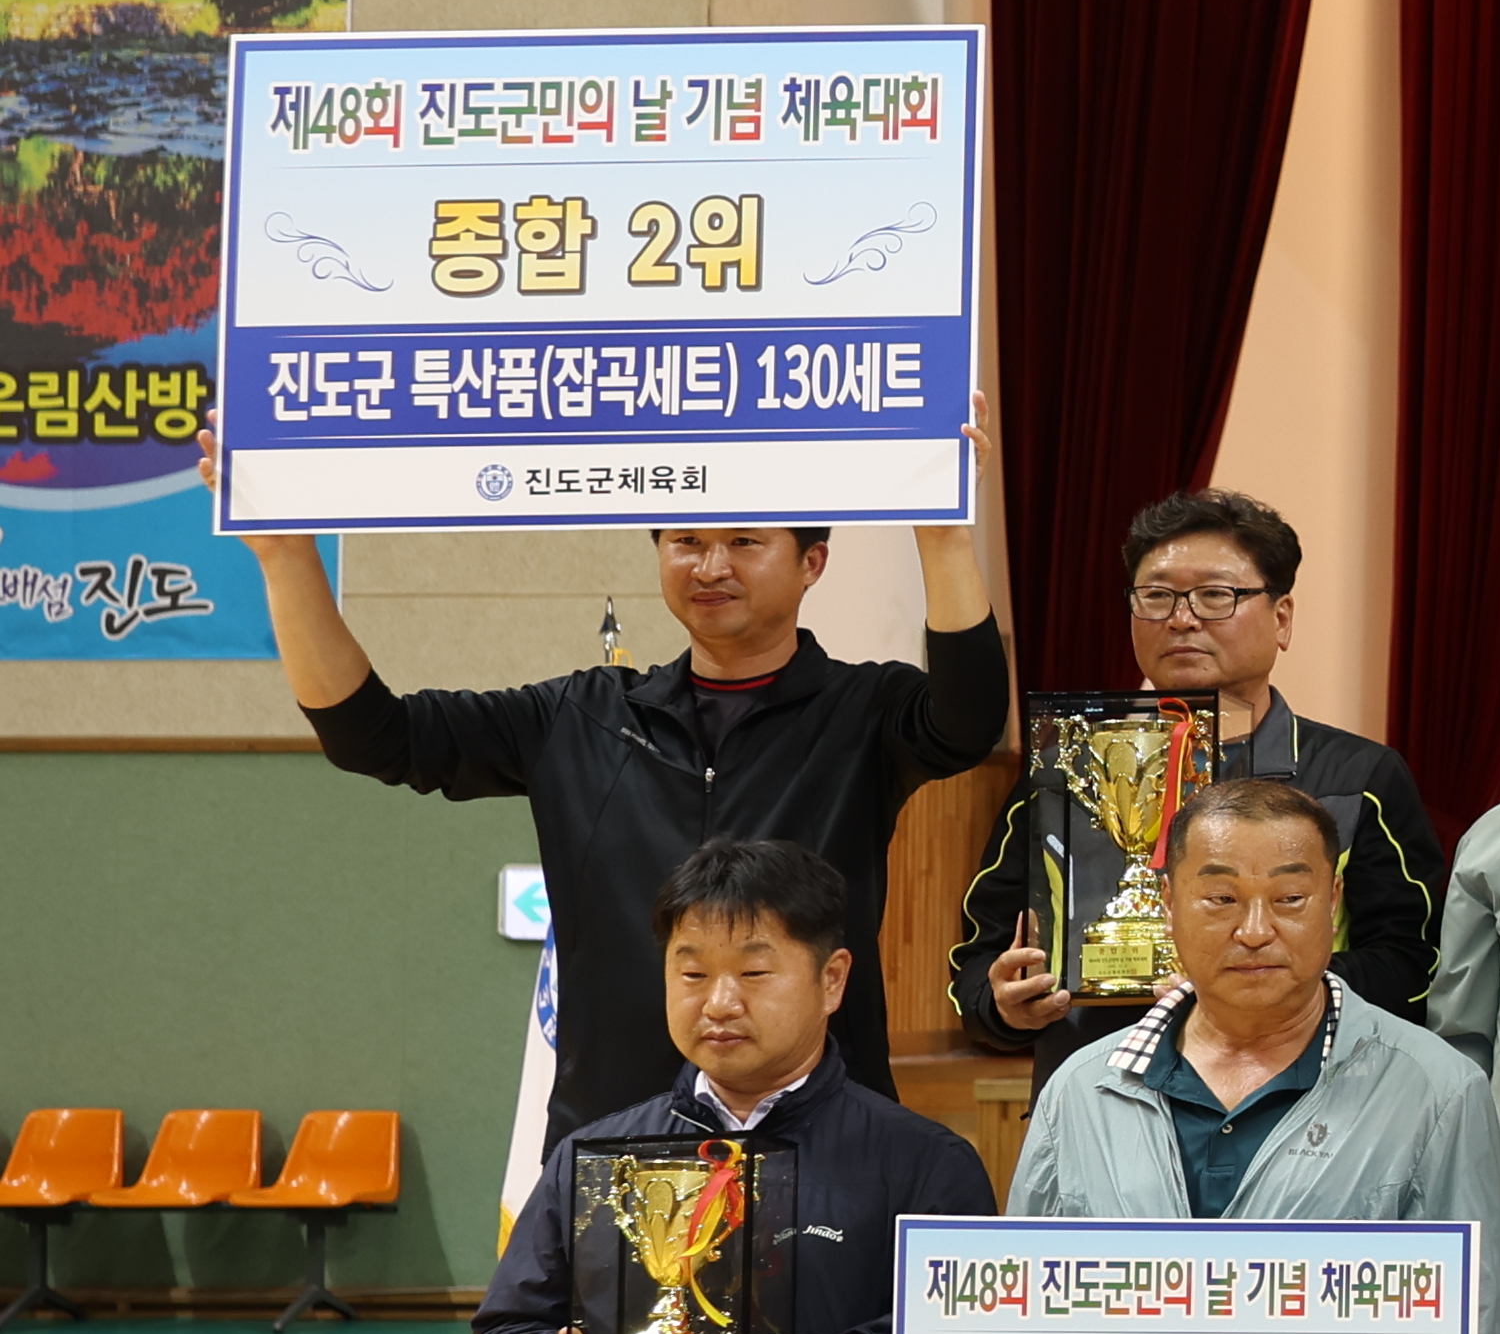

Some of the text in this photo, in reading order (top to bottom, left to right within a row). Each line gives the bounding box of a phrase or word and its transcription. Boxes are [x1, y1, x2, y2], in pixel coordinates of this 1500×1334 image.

[270, 73, 939, 151] 제48회 진도군민의 날 기념 체육대회
[430, 192, 764, 296] 종합 2위
[268, 340, 924, 423] 진도군 특산품(잡곡세트) 130세트
[525, 464, 709, 495] 진도군체육회
[0, 558, 211, 636] 배섬 진도
[801, 1224, 837, 1243] Jindo
[927, 1257, 1442, 1320] 제48회 진도군민의 날 기념 체육대회
